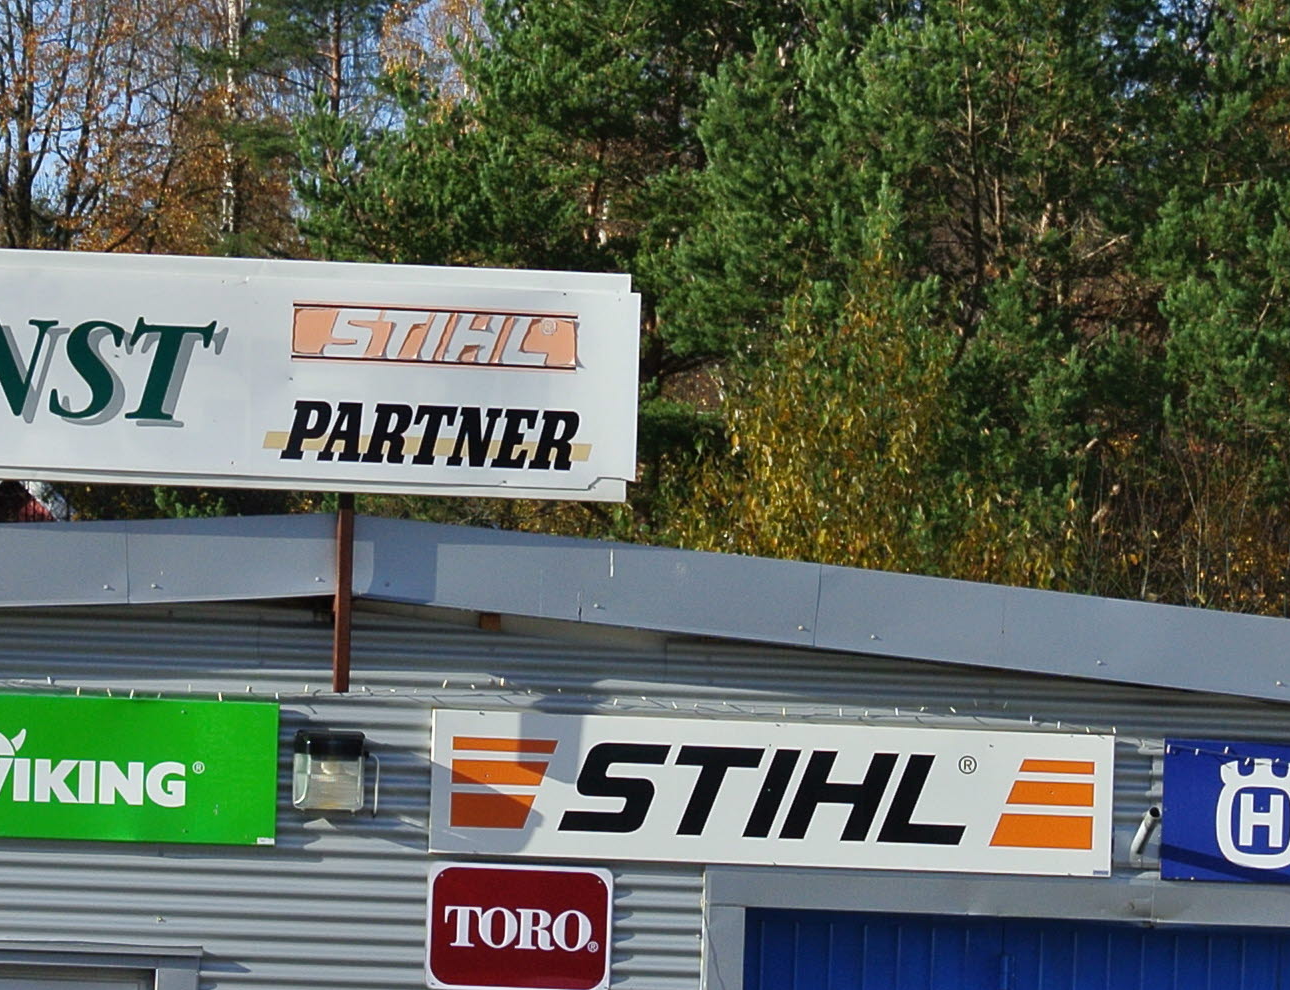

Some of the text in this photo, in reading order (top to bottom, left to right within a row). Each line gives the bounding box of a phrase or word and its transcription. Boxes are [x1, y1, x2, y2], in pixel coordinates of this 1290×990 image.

[319, 309, 549, 366] STIHL
[280, 400, 580, 471] PARTNER
[558, 741, 967, 846] STIHL
[444, 904, 590, 952] TORO
